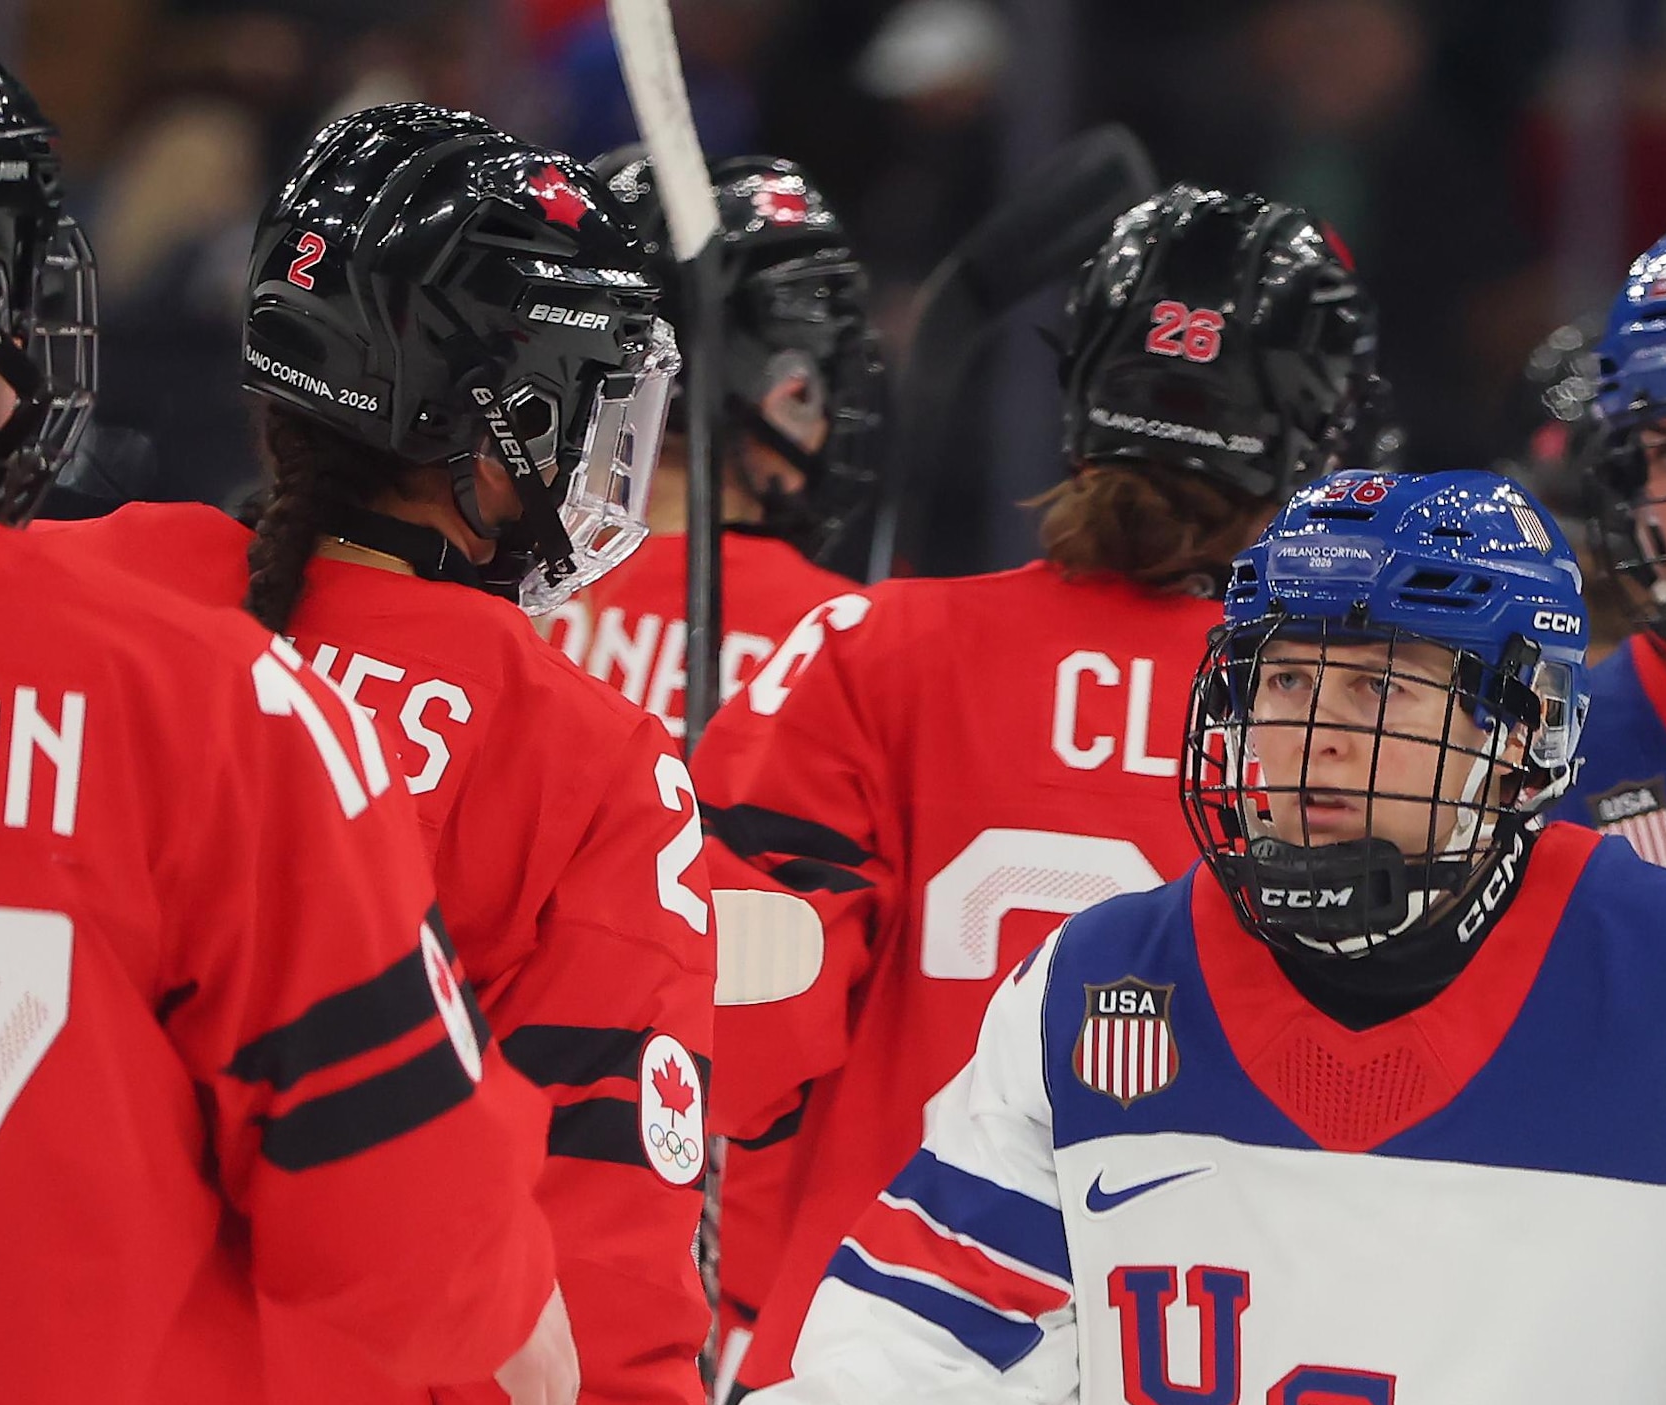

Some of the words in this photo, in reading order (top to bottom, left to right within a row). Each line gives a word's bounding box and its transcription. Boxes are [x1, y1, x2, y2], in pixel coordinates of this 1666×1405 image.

[287, 232, 326, 290] 2
[527, 304, 601, 331] BAUER
[1145, 300, 1226, 363] 26
[271, 362, 334, 400] CORTINA
[338, 389, 378, 411] 2026
[1277, 546, 1321, 559] MILANO
[1321, 546, 1372, 560] CORTINA
[1533, 611, 1581, 635] CCM
[654, 752, 708, 936] 2
[1260, 886, 1354, 909] CCM
[1457, 832, 1524, 944] CCM
[1099, 990, 1156, 1015] USA
